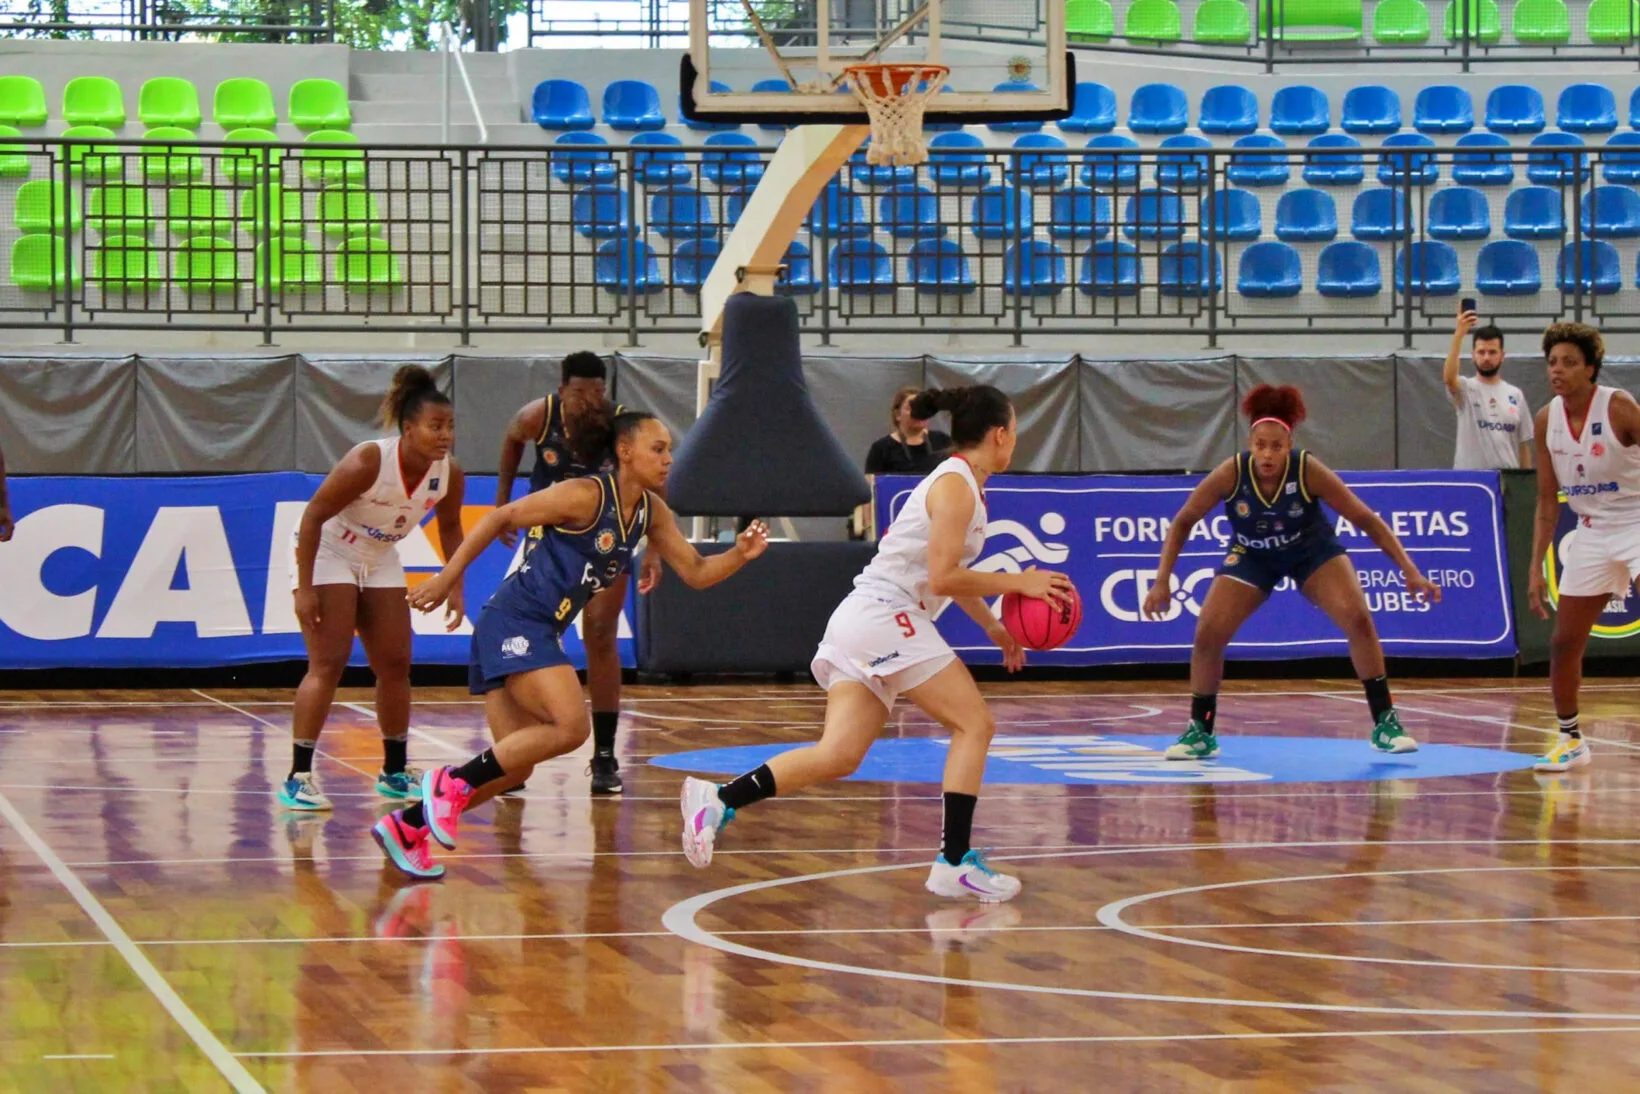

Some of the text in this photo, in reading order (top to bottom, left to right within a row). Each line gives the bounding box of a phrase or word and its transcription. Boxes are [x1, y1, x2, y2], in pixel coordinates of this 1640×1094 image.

[1095, 516, 1231, 548] FORAÇ
[1335, 511, 1469, 537] AETAS
[0, 502, 633, 641] CAI
[1357, 570, 1475, 588] BRASEIRO
[1365, 592, 1430, 612] UBES
[895, 611, 915, 638] 9
